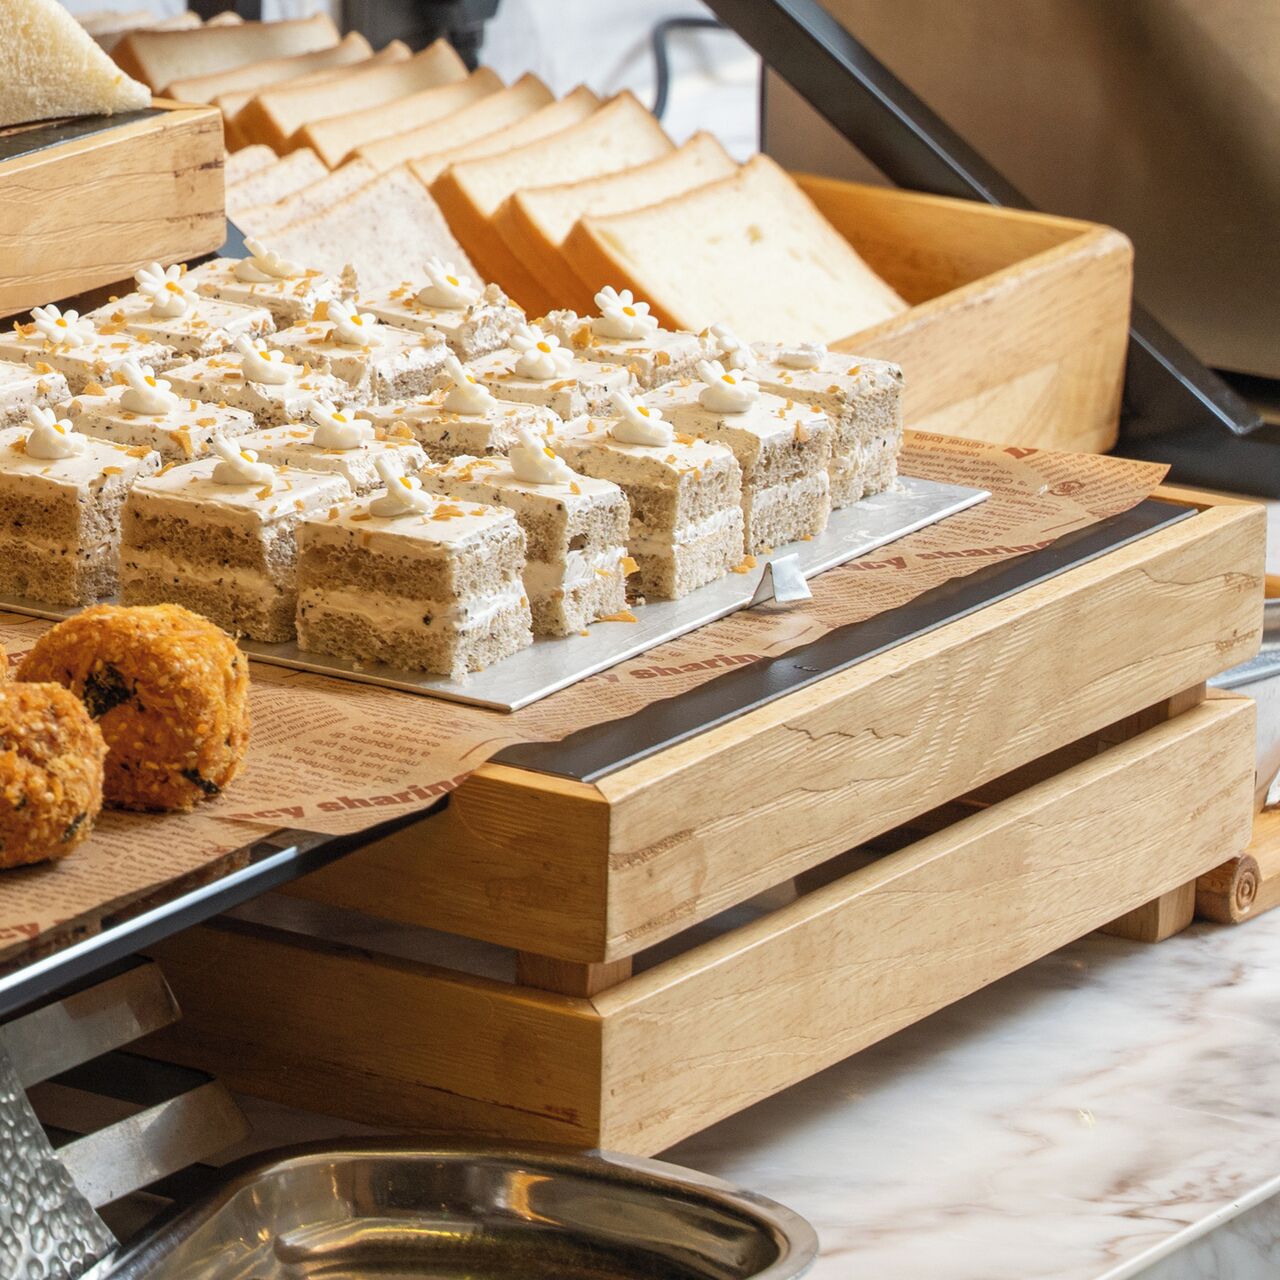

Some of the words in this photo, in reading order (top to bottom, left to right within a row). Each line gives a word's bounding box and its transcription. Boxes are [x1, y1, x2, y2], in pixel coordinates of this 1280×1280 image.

[630, 653, 763, 680] sharin
[349, 735, 394, 750] course
[338, 744, 363, 756] this
[396, 744, 418, 756] full
[321, 751, 356, 765] enjoy
[365, 751, 421, 768] member
[360, 761, 387, 771] just
[344, 769, 371, 779] and
